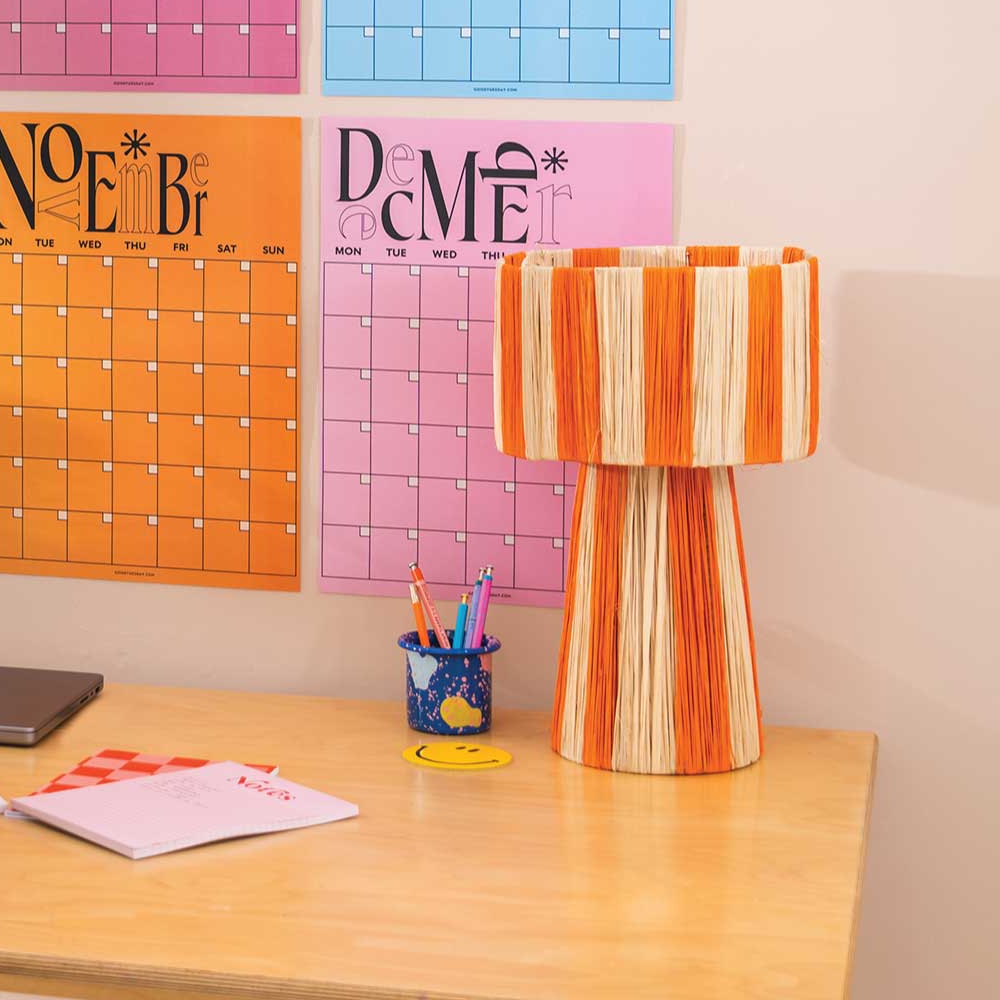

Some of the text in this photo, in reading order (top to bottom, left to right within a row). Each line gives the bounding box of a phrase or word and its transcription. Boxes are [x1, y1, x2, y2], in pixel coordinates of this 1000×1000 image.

[35, 238, 55, 248] TUE
[78, 239, 102, 249] WED
[124, 241, 146, 251] THU
[173, 242, 189, 252] FRI
[217, 244, 237, 254] SAT
[262, 245, 285, 255] SUN
[335, 246, 362, 256] MON
[385, 247, 407, 258] TUE
[432, 249, 457, 259] WED
